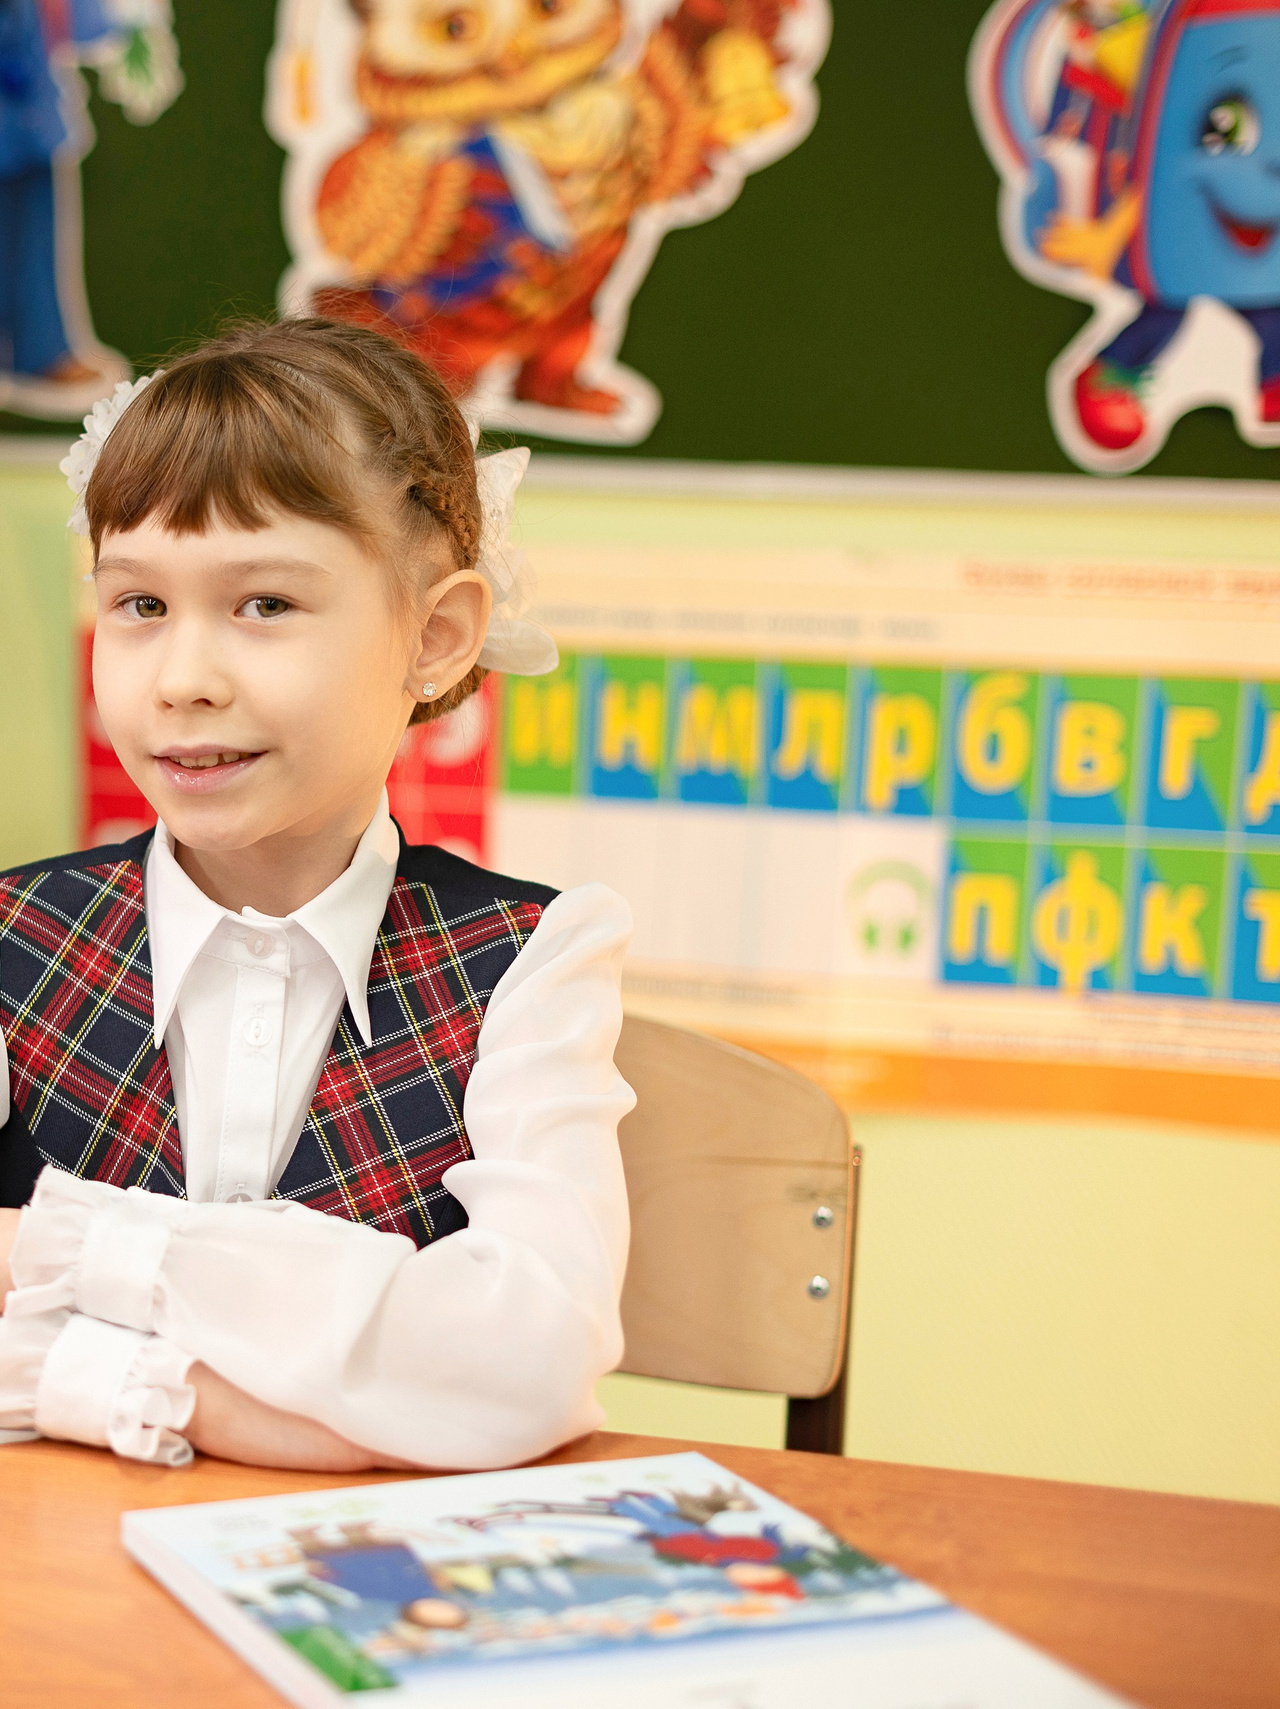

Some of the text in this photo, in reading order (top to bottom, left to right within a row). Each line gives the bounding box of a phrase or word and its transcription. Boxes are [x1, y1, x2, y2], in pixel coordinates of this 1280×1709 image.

[597, 680, 663, 772] н
[677, 683, 762, 778] м
[773, 688, 848, 780] л
[862, 692, 938, 811] р
[956, 670, 1045, 796] б
[1052, 698, 1126, 798] в
[1158, 704, 1221, 800] г
[948, 870, 1020, 963] п
[1030, 848, 1126, 1000] ф
[1138, 880, 1210, 974] к
